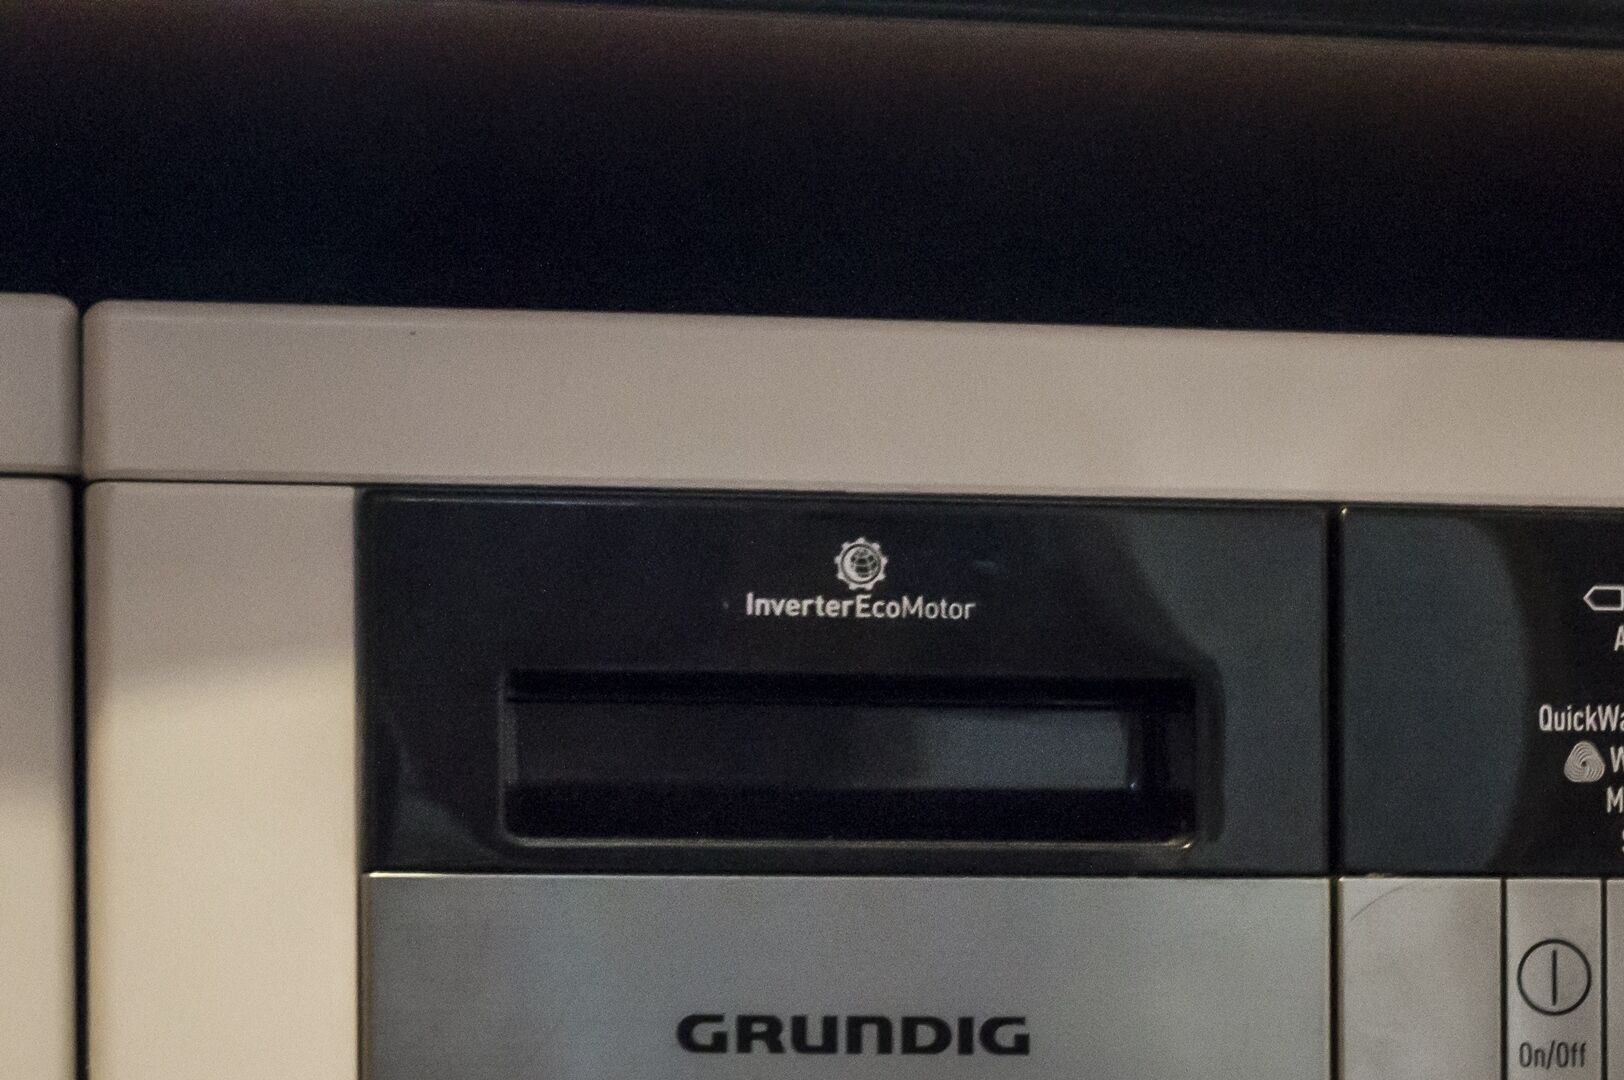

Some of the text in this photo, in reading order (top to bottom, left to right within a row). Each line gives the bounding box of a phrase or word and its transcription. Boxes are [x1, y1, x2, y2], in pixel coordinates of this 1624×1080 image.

[745, 592, 975, 620] InverterEcoMotor
[676, 1014, 1031, 1055] GRUNDIG
[1519, 1041, 1587, 1070] On/Off
